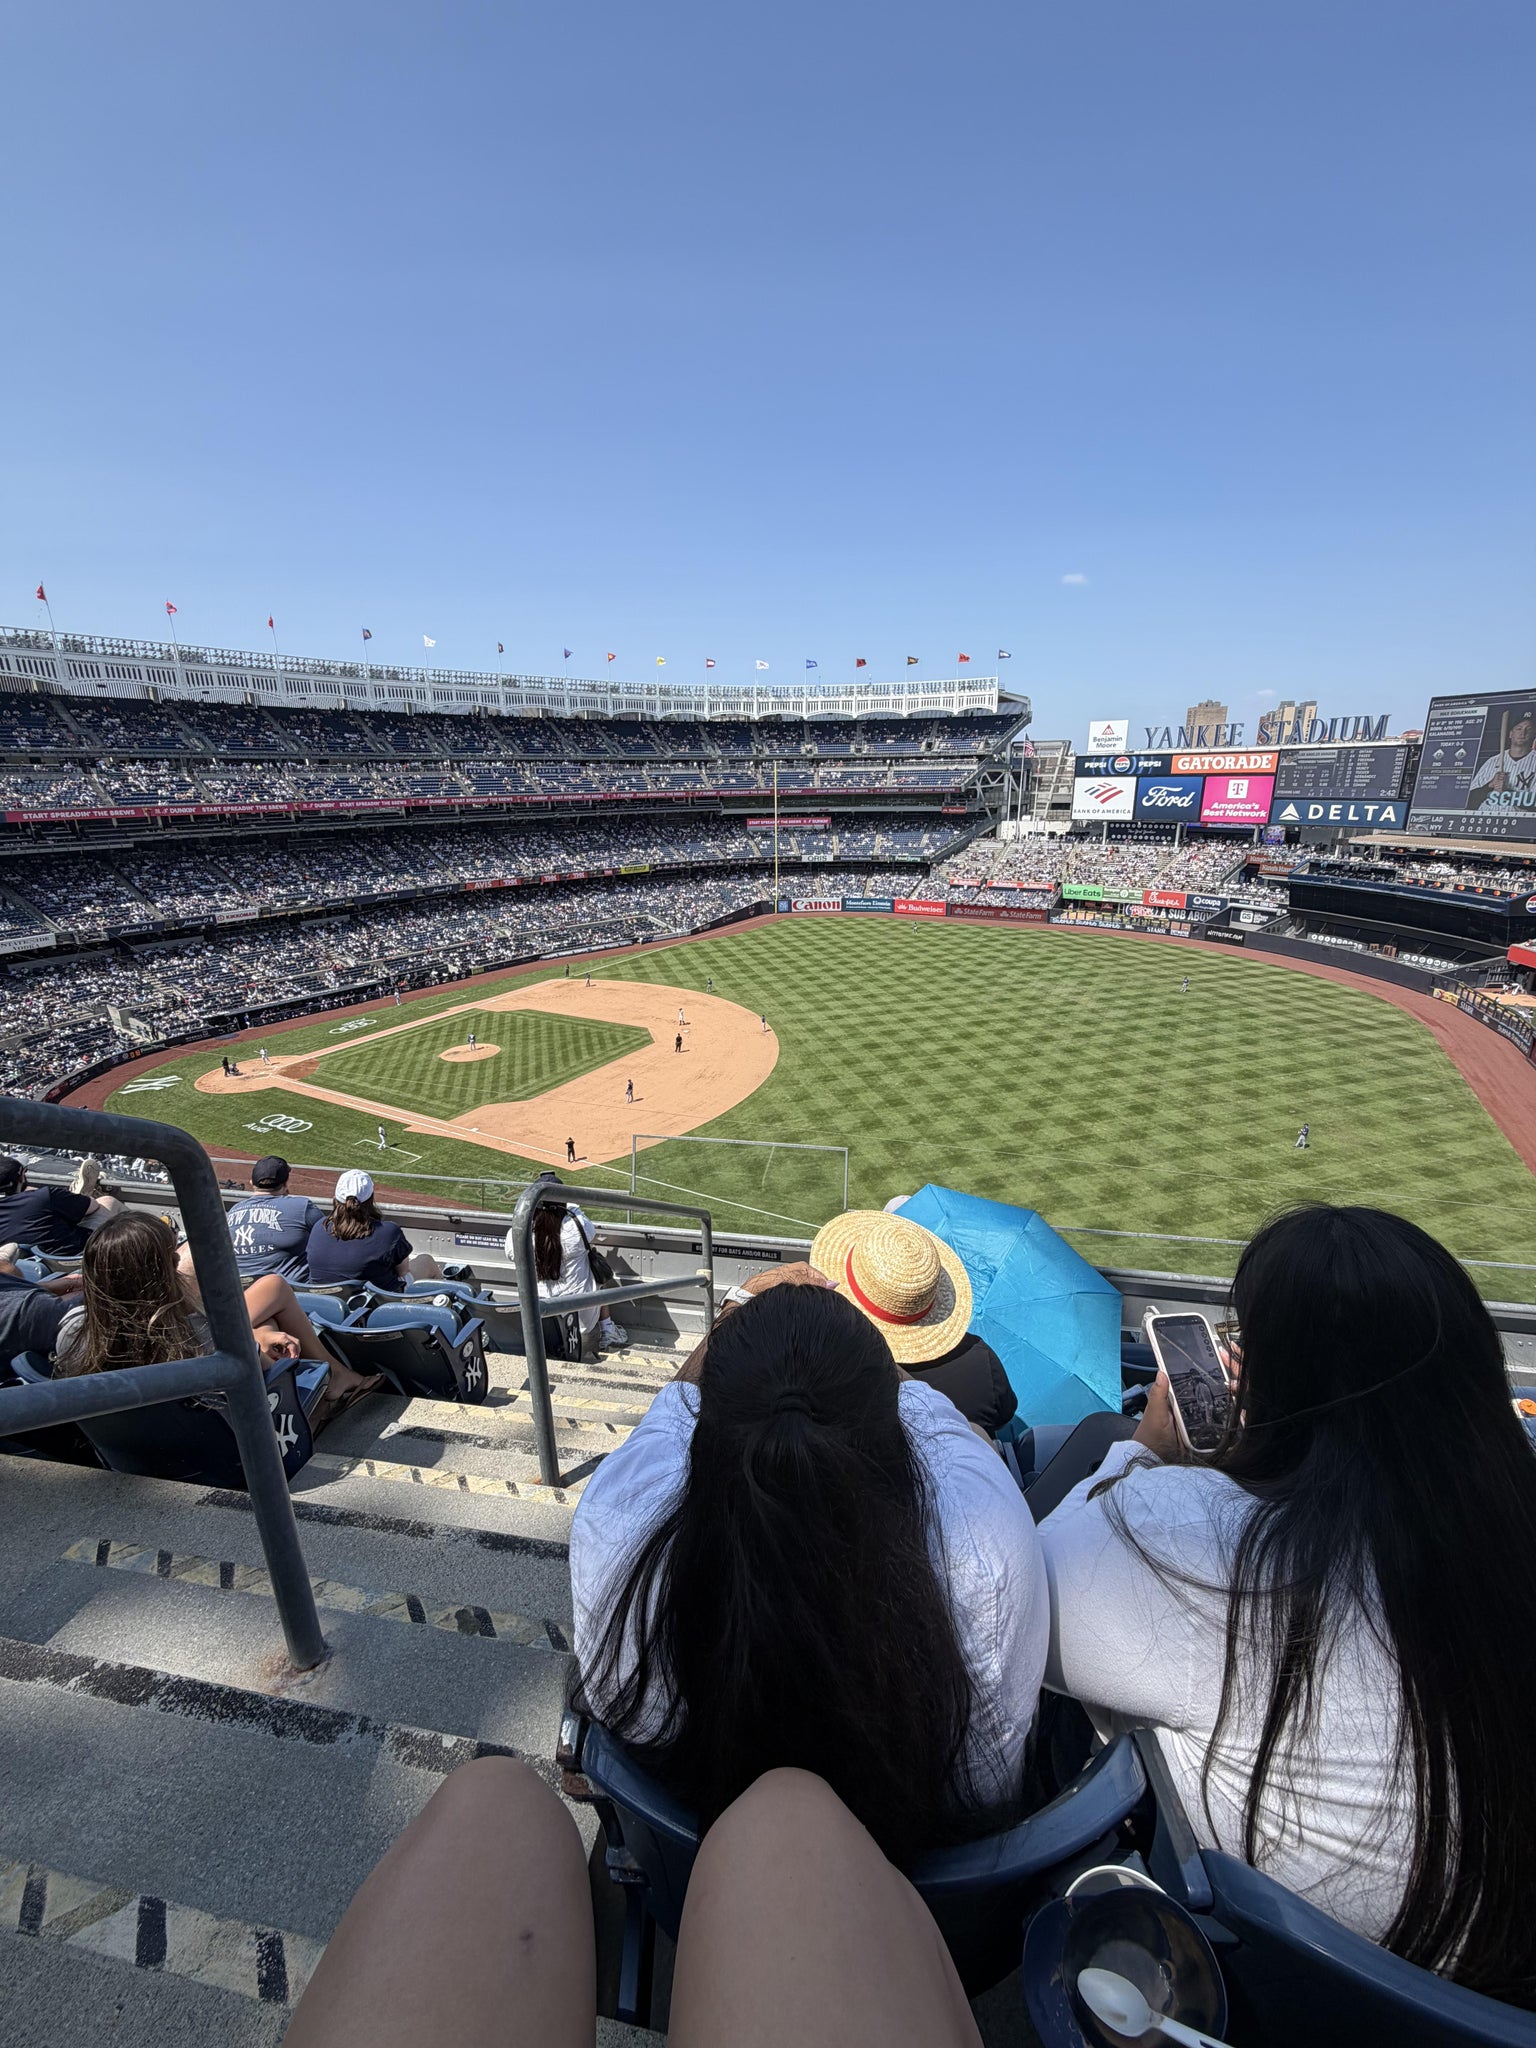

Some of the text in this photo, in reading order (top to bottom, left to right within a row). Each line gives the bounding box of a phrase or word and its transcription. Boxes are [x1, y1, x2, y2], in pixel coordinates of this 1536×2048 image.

[1144, 714, 1392, 749] YANKEE STADIUM
[1177, 755, 1273, 771] GATORADE
[1142, 786, 1196, 808] Ford
[1488, 790, 1536, 807] SCHU
[1212, 802, 1260, 810] America's
[1203, 809, 1267, 818] Best Network
[1308, 804, 1396, 822] DELTA
[1083, 889, 1101, 897] Eats
[792, 900, 840, 910] Canon
[1201, 898, 1221, 907] coupa
[908, 904, 943, 913] Budweiser
[1168, 909, 1186, 920] SUB
[242, 1122, 273, 1133] Audi
[228, 1208, 283, 1232] EW YORK
[233, 1225, 255, 1247] NY
[233, 1244, 274, 1255] NKEES
[742, 1249, 761, 1257] AND/OR
